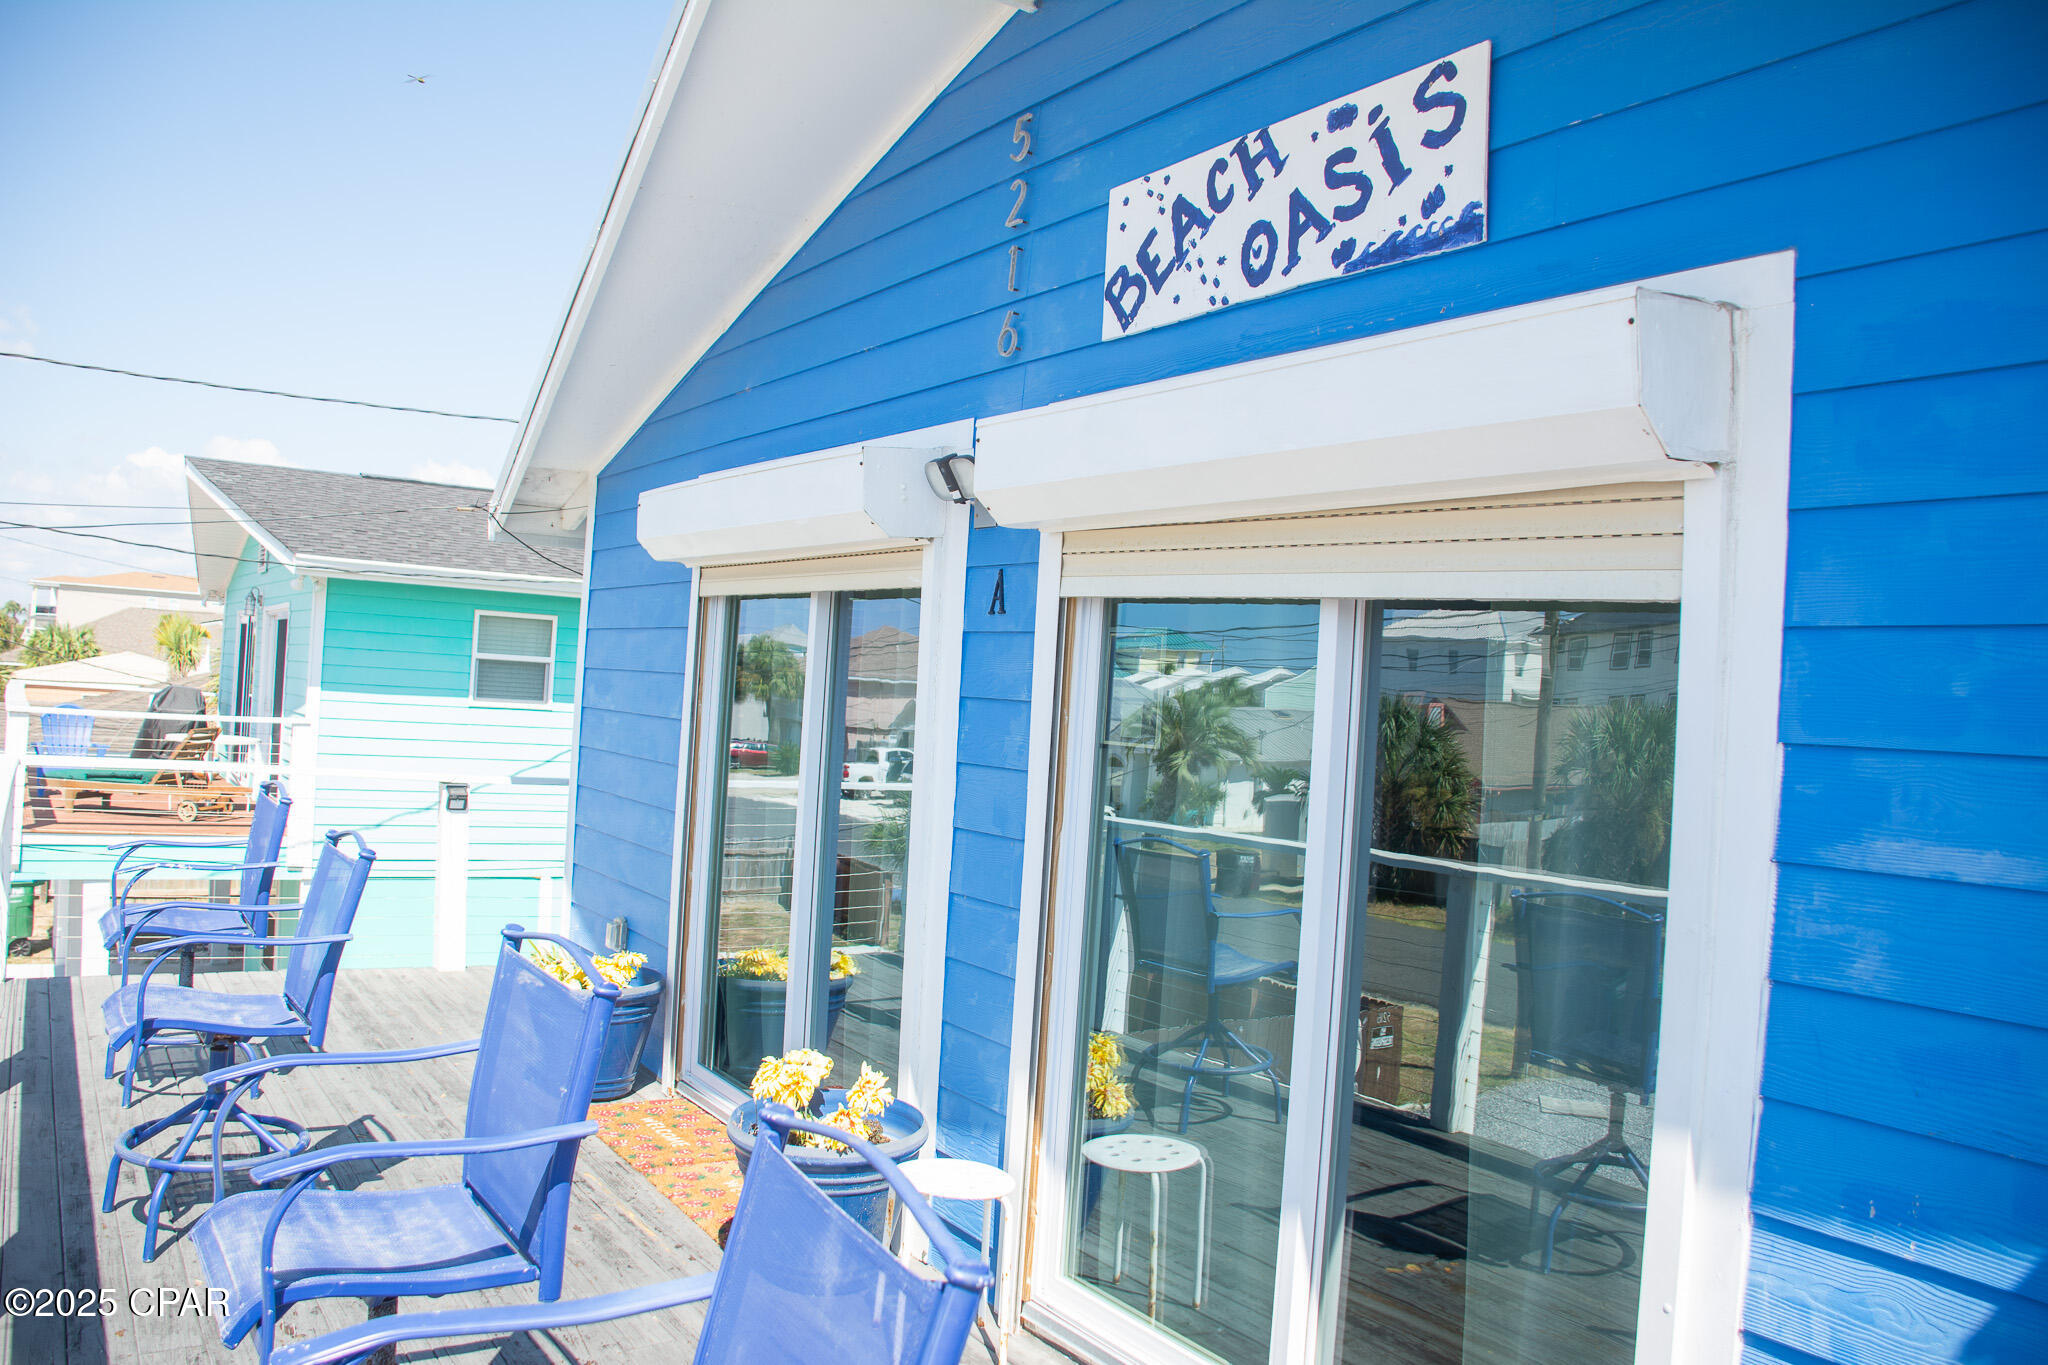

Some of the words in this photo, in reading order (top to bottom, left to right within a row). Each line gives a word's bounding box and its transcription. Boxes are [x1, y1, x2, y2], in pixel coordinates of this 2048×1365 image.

[998, 112, 1032, 357] 5216
[1105, 127, 1290, 333] BEACH
[987, 568, 1006, 615] A
[641, 1117, 690, 1147] WELCOME
